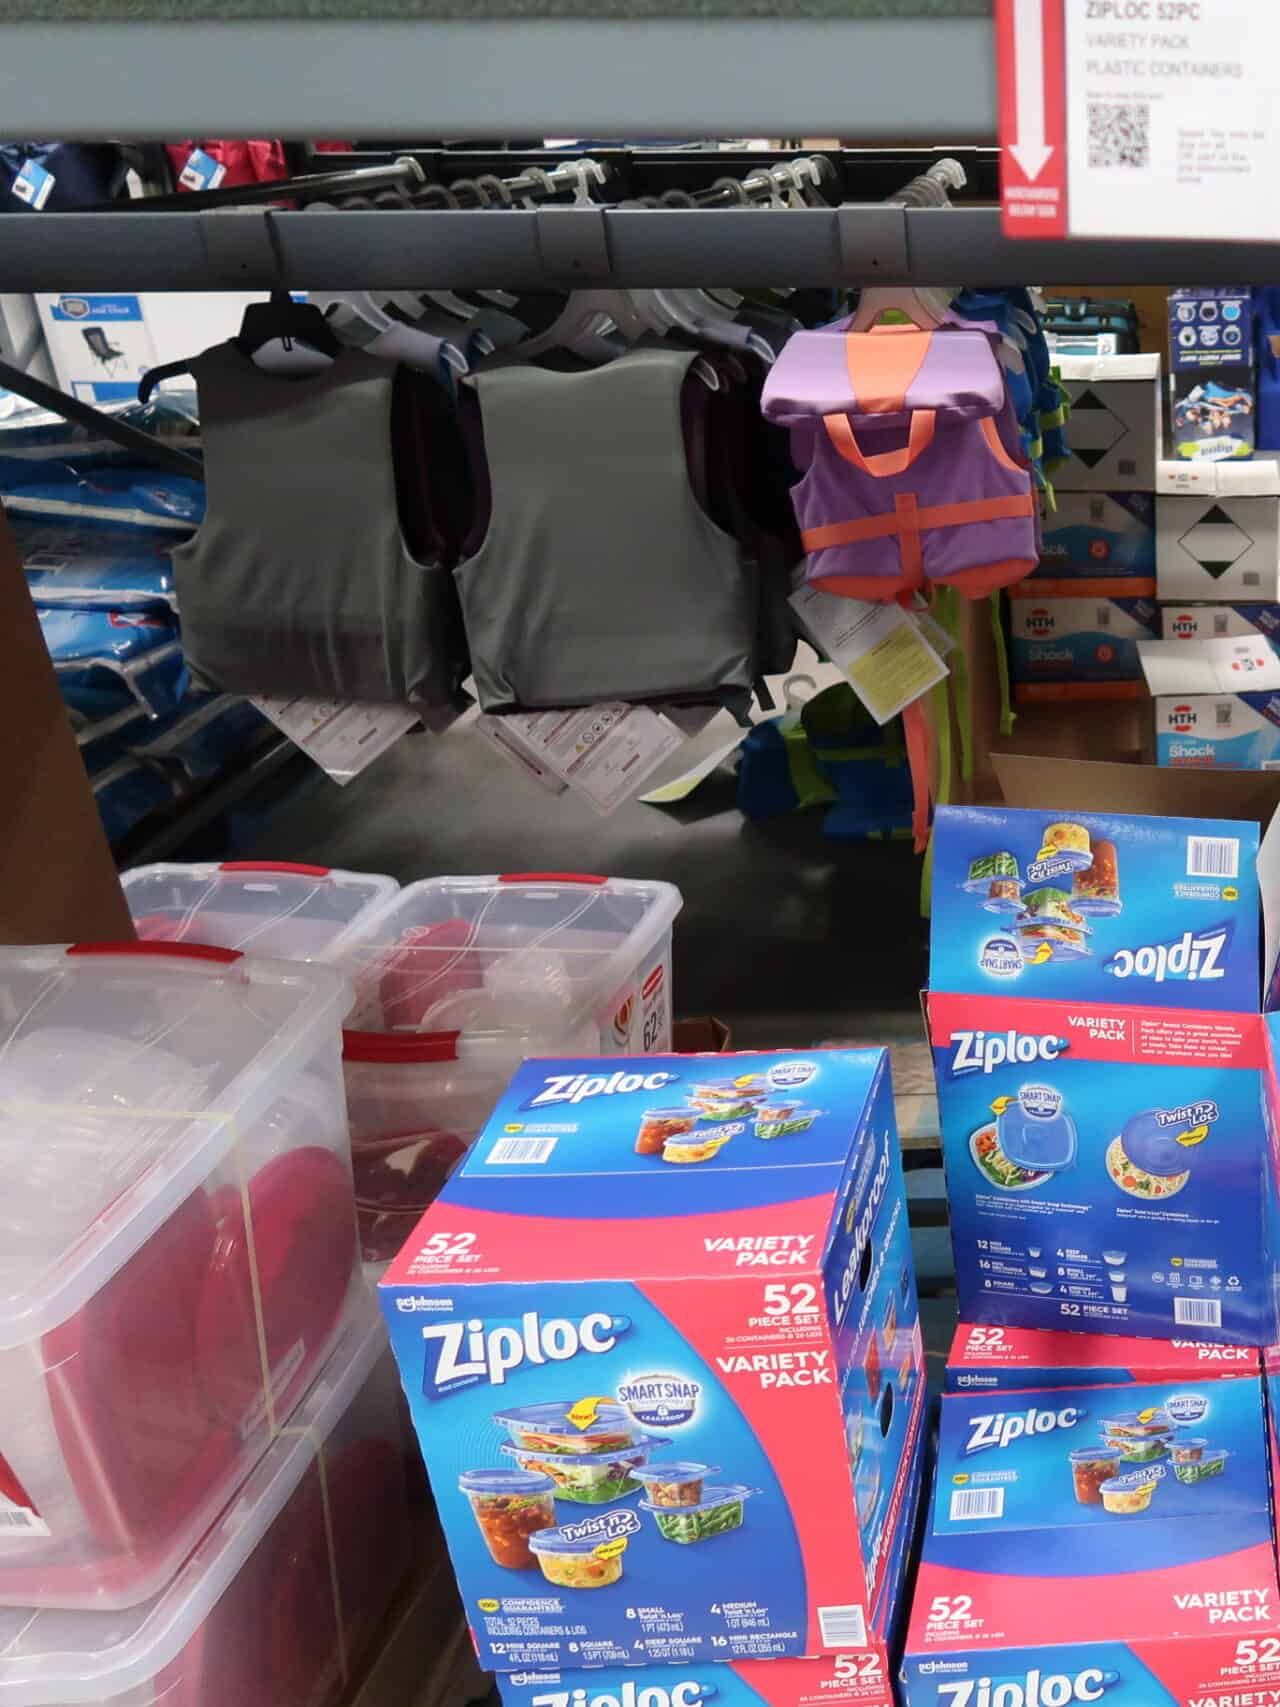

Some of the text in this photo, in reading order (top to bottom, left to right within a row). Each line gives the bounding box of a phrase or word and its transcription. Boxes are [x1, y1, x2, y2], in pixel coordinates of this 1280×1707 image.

[1085, 0, 1150, 20] ZIPLOC
[1086, 32, 1190, 49] VARIETY PACK
[1086, 60, 1243, 79] PLASTIC CONTAINERS
[1172, 621, 1198, 633] HTH
[1168, 713, 1197, 724] HTH
[1168, 743, 1217, 758] Shock
[1110, 931, 1228, 982] Ziploc
[1067, 1015, 1126, 1030] VARIETY
[1088, 1027, 1126, 1041] PACK
[949, 1029, 1062, 1074] Ziploc
[529, 1071, 672, 1107] Ziploc
[834, 1129, 890, 1326] Leakproof
[420, 1232, 477, 1255] 52
[703, 1234, 815, 1253] VARIETY
[976, 1239, 989, 1250] 12
[413, 1254, 482, 1264] PIECE SET
[734, 1249, 809, 1267] PACK
[979, 1259, 991, 1270] 16
[763, 1282, 819, 1315] 52
[1060, 1303, 1129, 1317] 52 PIECE SET
[747, 1313, 821, 1328] PIECE SET
[968, 1328, 1006, 1346] 52
[421, 1312, 617, 1386] Ziploc
[965, 1344, 1014, 1353] PIECE SET
[1198, 1347, 1250, 1361] PACK
[715, 1349, 830, 1374] VARIETY
[760, 1367, 833, 1390] PACK
[967, 1406, 1080, 1447] Ziploc
[562, 1519, 605, 1541] Twist
[1173, 1588, 1270, 1610] VARIETY
[626, 1607, 637, 1619] 8
[711, 1603, 721, 1615] 4
[928, 1594, 973, 1622] 52
[1208, 1606, 1272, 1624] PACK
[926, 1618, 985, 1631] PIECE SET
[490, 1642, 506, 1654] 12
[568, 1641, 579, 1653] 8
[633, 1638, 645, 1651] 4
[711, 1635, 728, 1648] 16
[833, 1653, 883, 1679] 52
[1220, 1664, 1257, 1676] PIECE
[820, 1675, 884, 1689] PIECE SET
